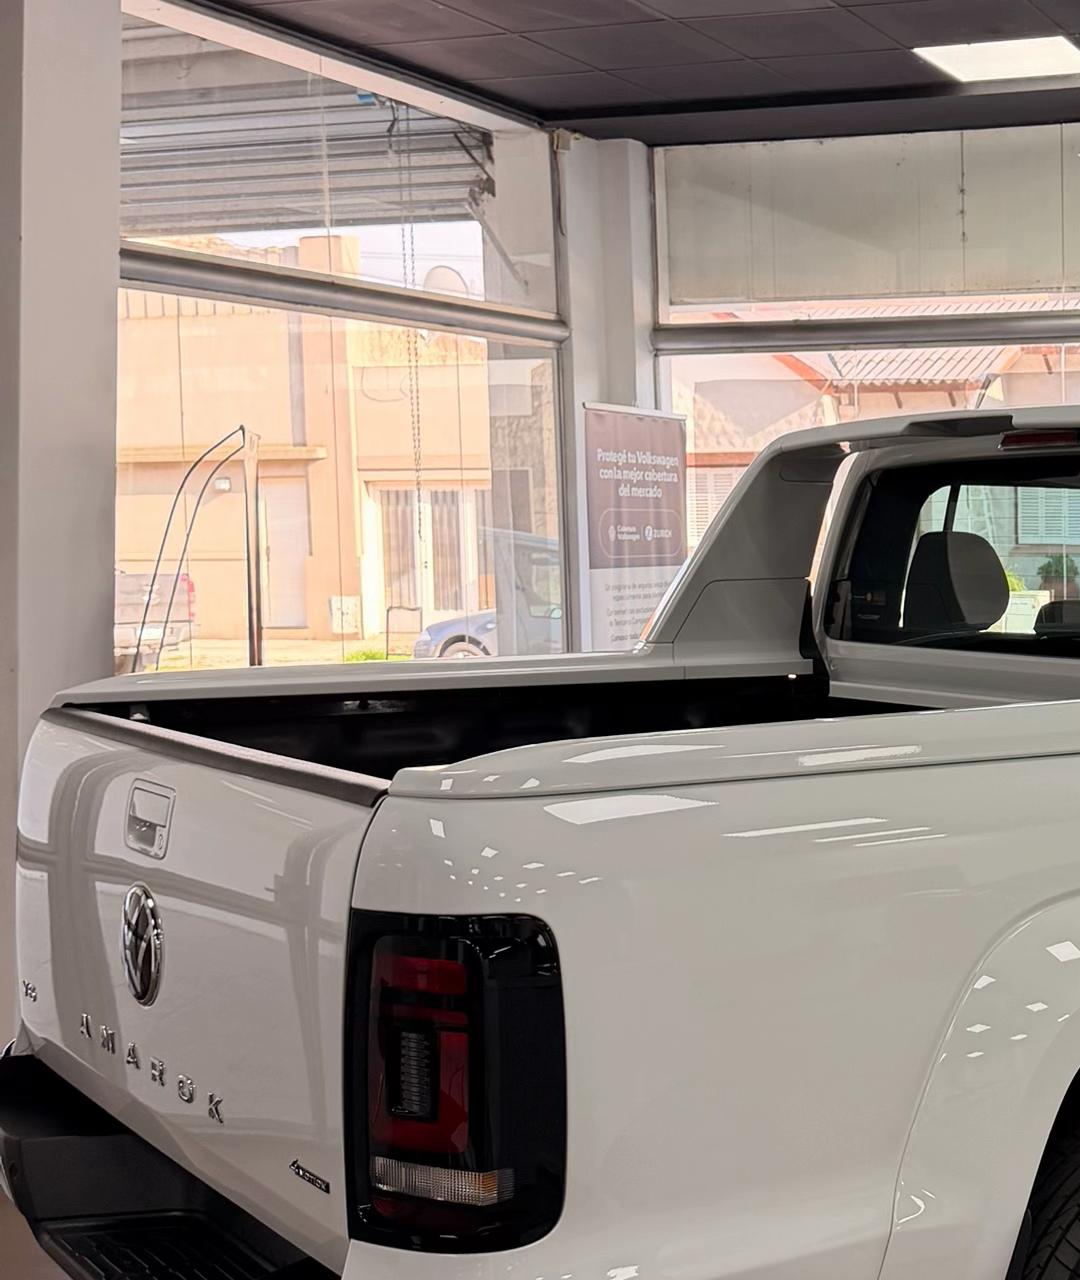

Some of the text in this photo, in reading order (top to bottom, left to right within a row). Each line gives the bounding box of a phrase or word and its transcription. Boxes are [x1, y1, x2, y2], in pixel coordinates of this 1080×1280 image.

[597, 448, 626, 465] Protegé
[637, 451, 678, 469] Volkswagen
[600, 468, 613, 479] con
[623, 467, 643, 483] mejor
[618, 483, 662, 498] del mercado
[80, 1013, 224, 1125] AMAROK
